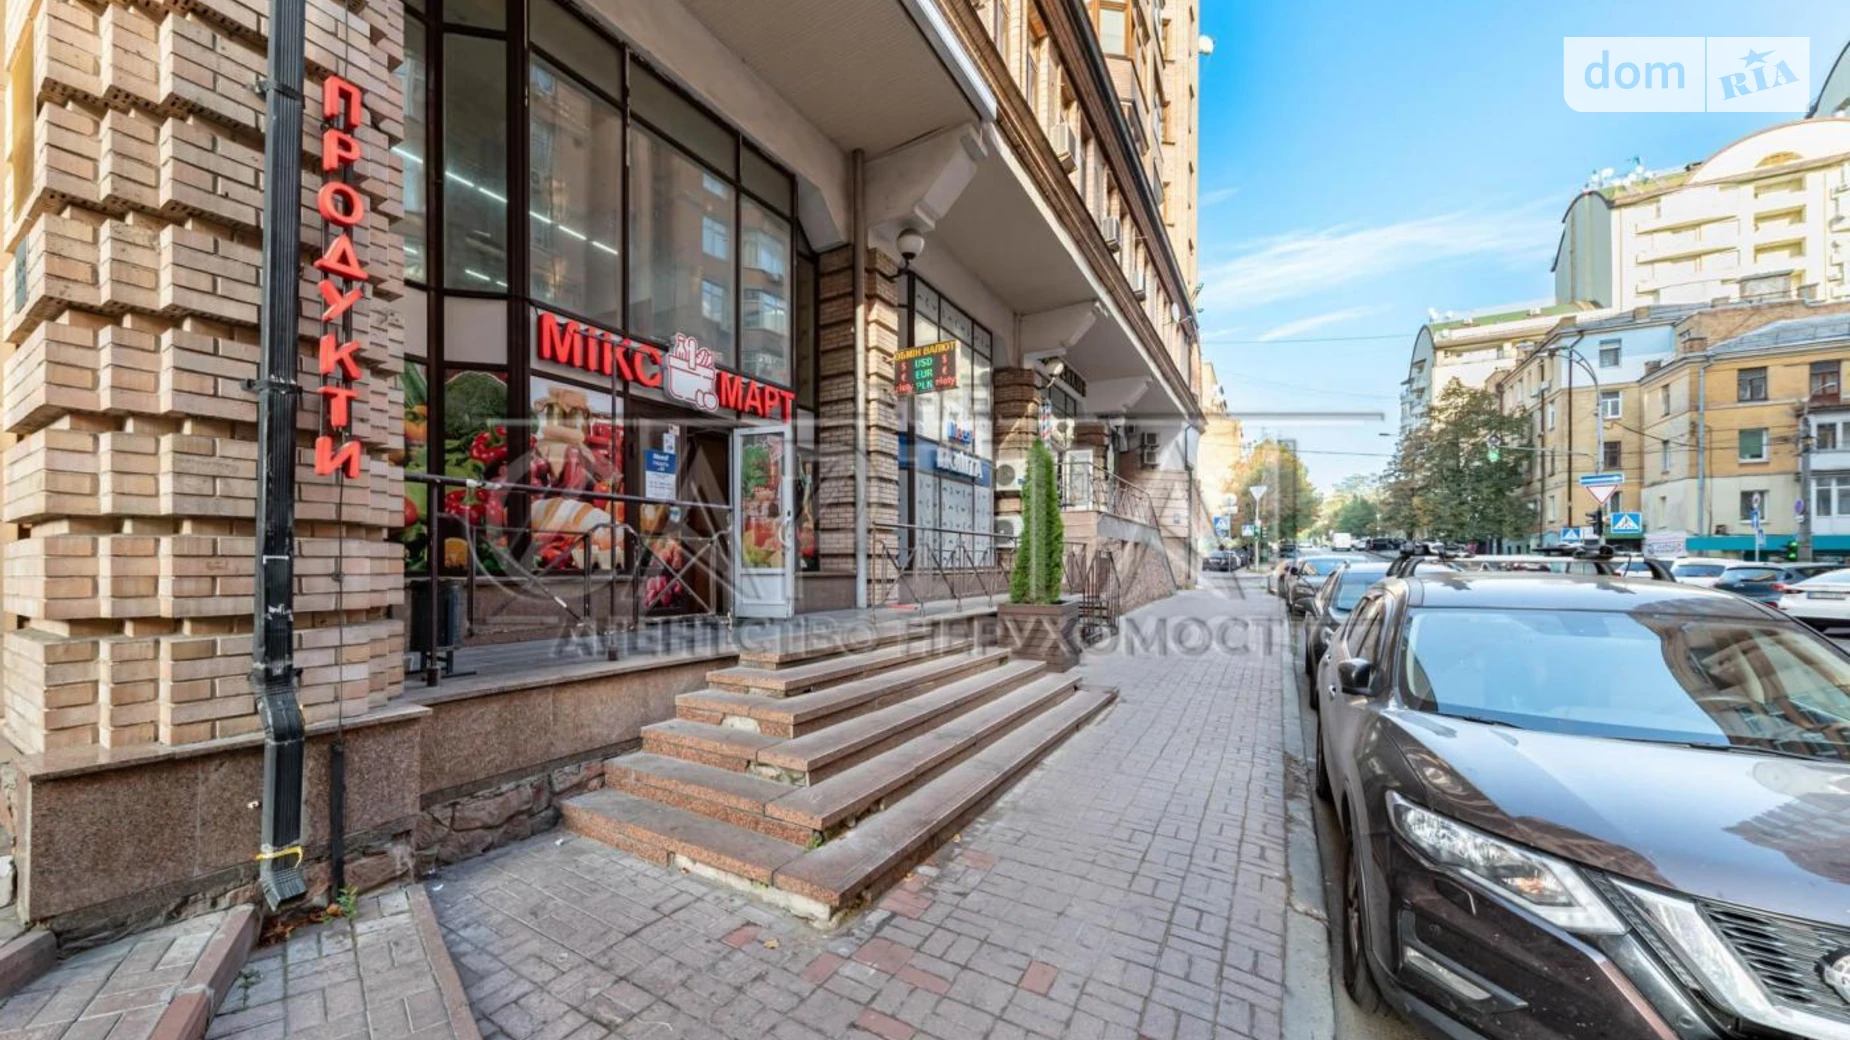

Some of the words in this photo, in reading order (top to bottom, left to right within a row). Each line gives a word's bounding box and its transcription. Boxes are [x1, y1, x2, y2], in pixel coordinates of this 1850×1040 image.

[314, 75, 368, 478] ПРОДУКТИ
[915, 356, 932, 367] USD
[538, 312, 663, 387] МІКС
[717, 371, 796, 424] МАРТ
[915, 368, 933, 379] EUR
[916, 379, 934, 390] PLN
